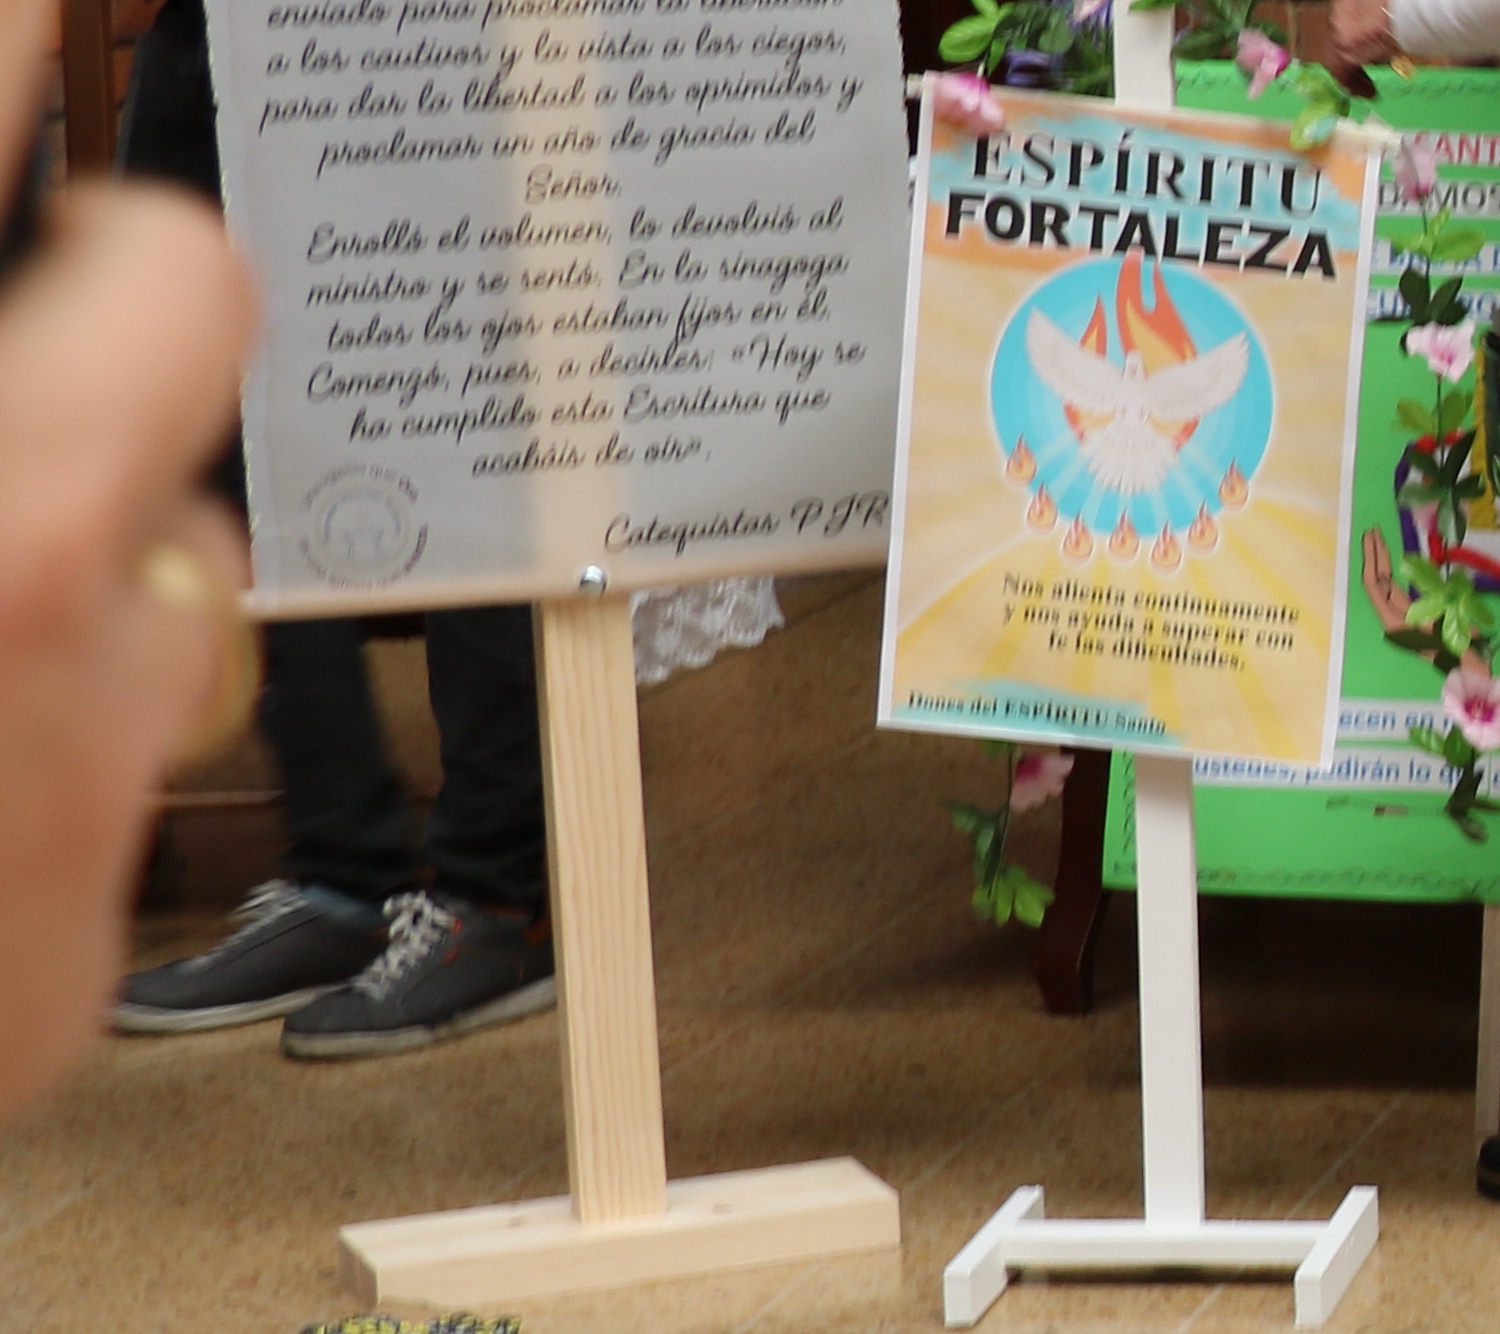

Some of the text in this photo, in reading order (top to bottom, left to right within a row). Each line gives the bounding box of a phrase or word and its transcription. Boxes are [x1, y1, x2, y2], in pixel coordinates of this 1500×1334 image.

[971, 128, 1321, 216] ESPÍRITU
[438, 216, 470, 252] el
[630, 206, 663, 241] lo
[809, 197, 845, 231] al
[945, 192, 1337, 282] FORTALEZA
[557, 356, 581, 381] a
[834, 344, 867, 366] se
[604, 504, 780, 557] Catequistas
[907, 688, 1169, 737] Dones del ESPÍRITU Santo
[1409, 757, 1432, 784] lo
